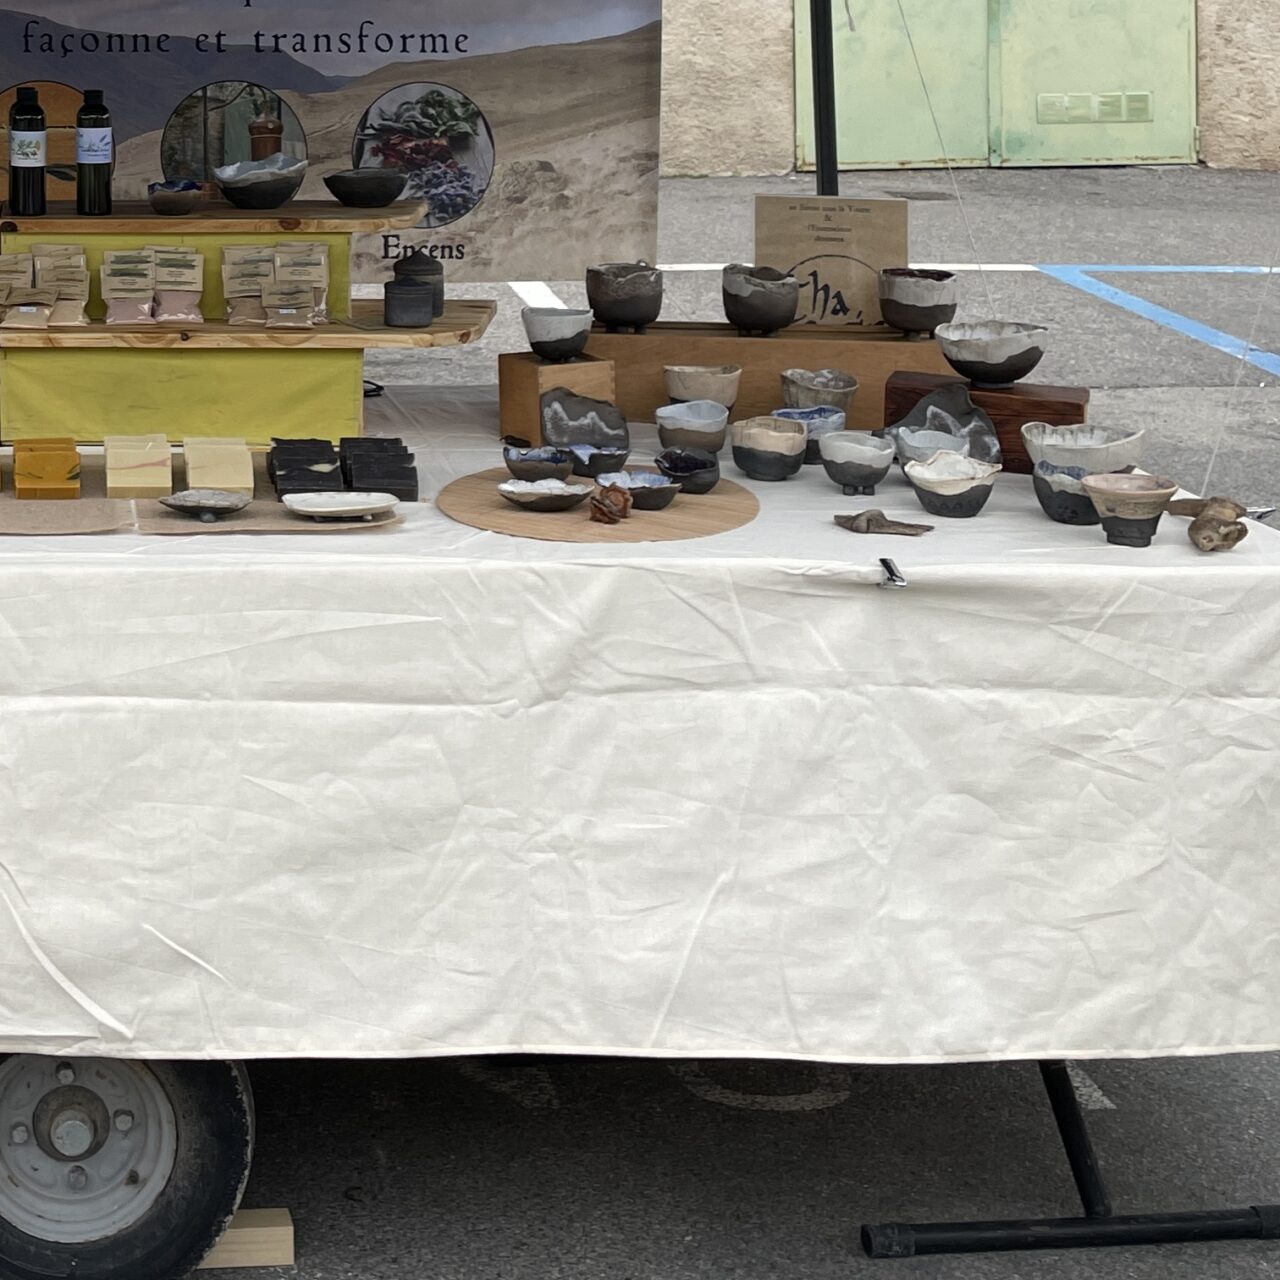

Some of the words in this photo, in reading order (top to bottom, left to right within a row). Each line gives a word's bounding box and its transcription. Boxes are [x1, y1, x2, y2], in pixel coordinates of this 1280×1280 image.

[23, 20, 172, 60] façonne
[195, 29, 228, 55] et
[253, 20, 471, 56] transforme
[382, 235, 465, 260] Encens
[799, 270, 849, 321] ha
